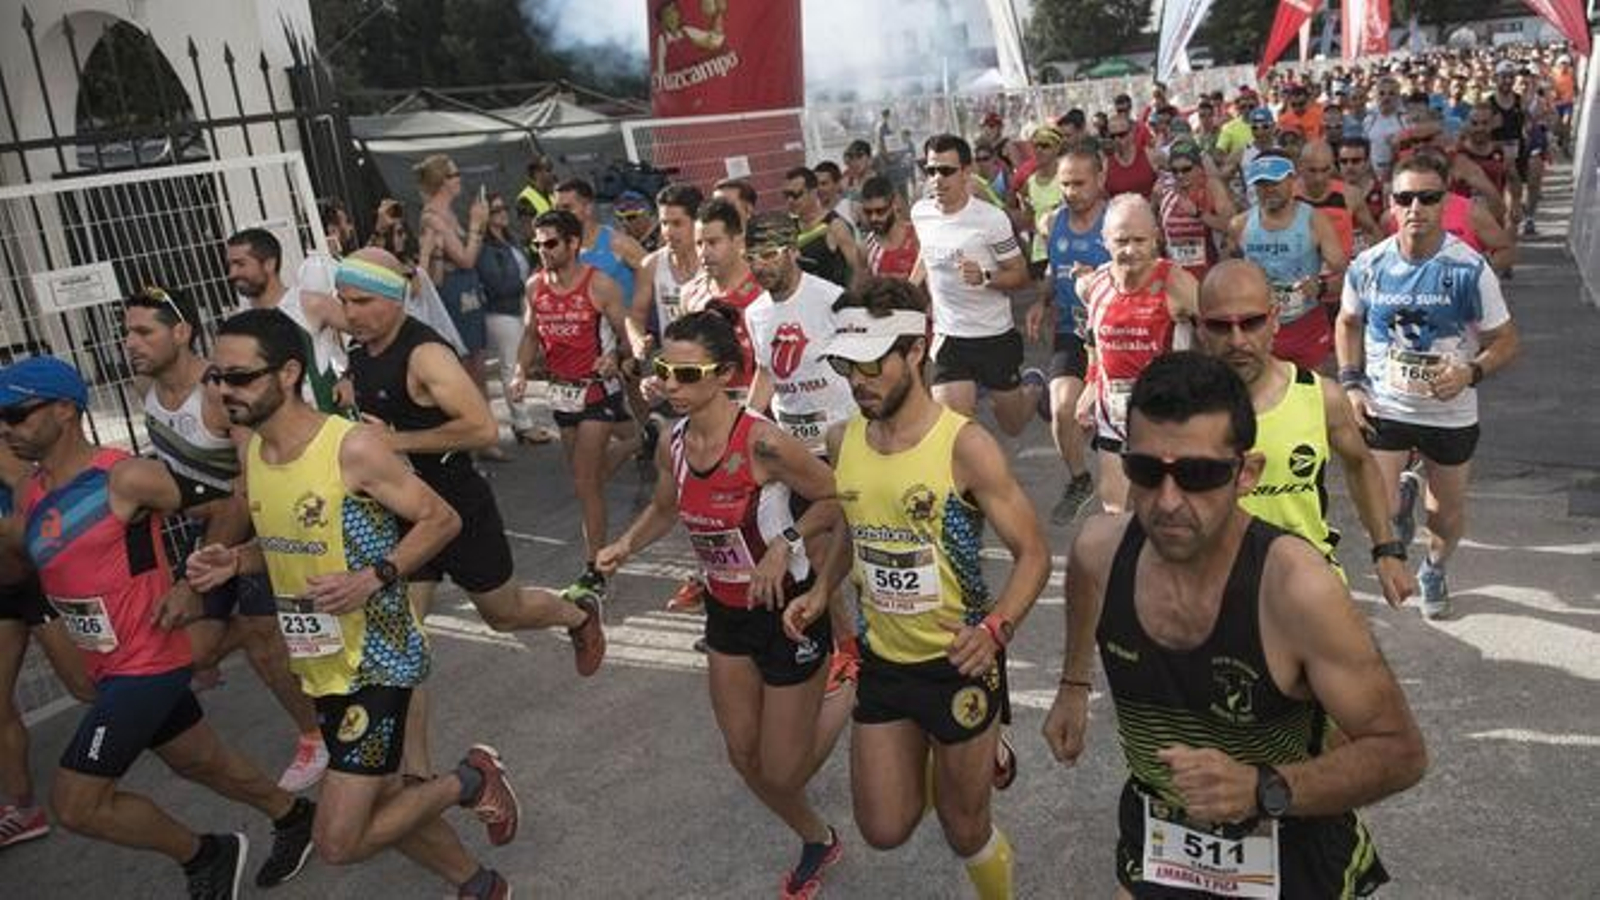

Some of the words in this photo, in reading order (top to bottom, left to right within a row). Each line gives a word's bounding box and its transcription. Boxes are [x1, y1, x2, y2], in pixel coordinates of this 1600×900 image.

[875, 569, 920, 591] 562
[283, 616, 322, 634] 233
[1184, 832, 1244, 866] 511
